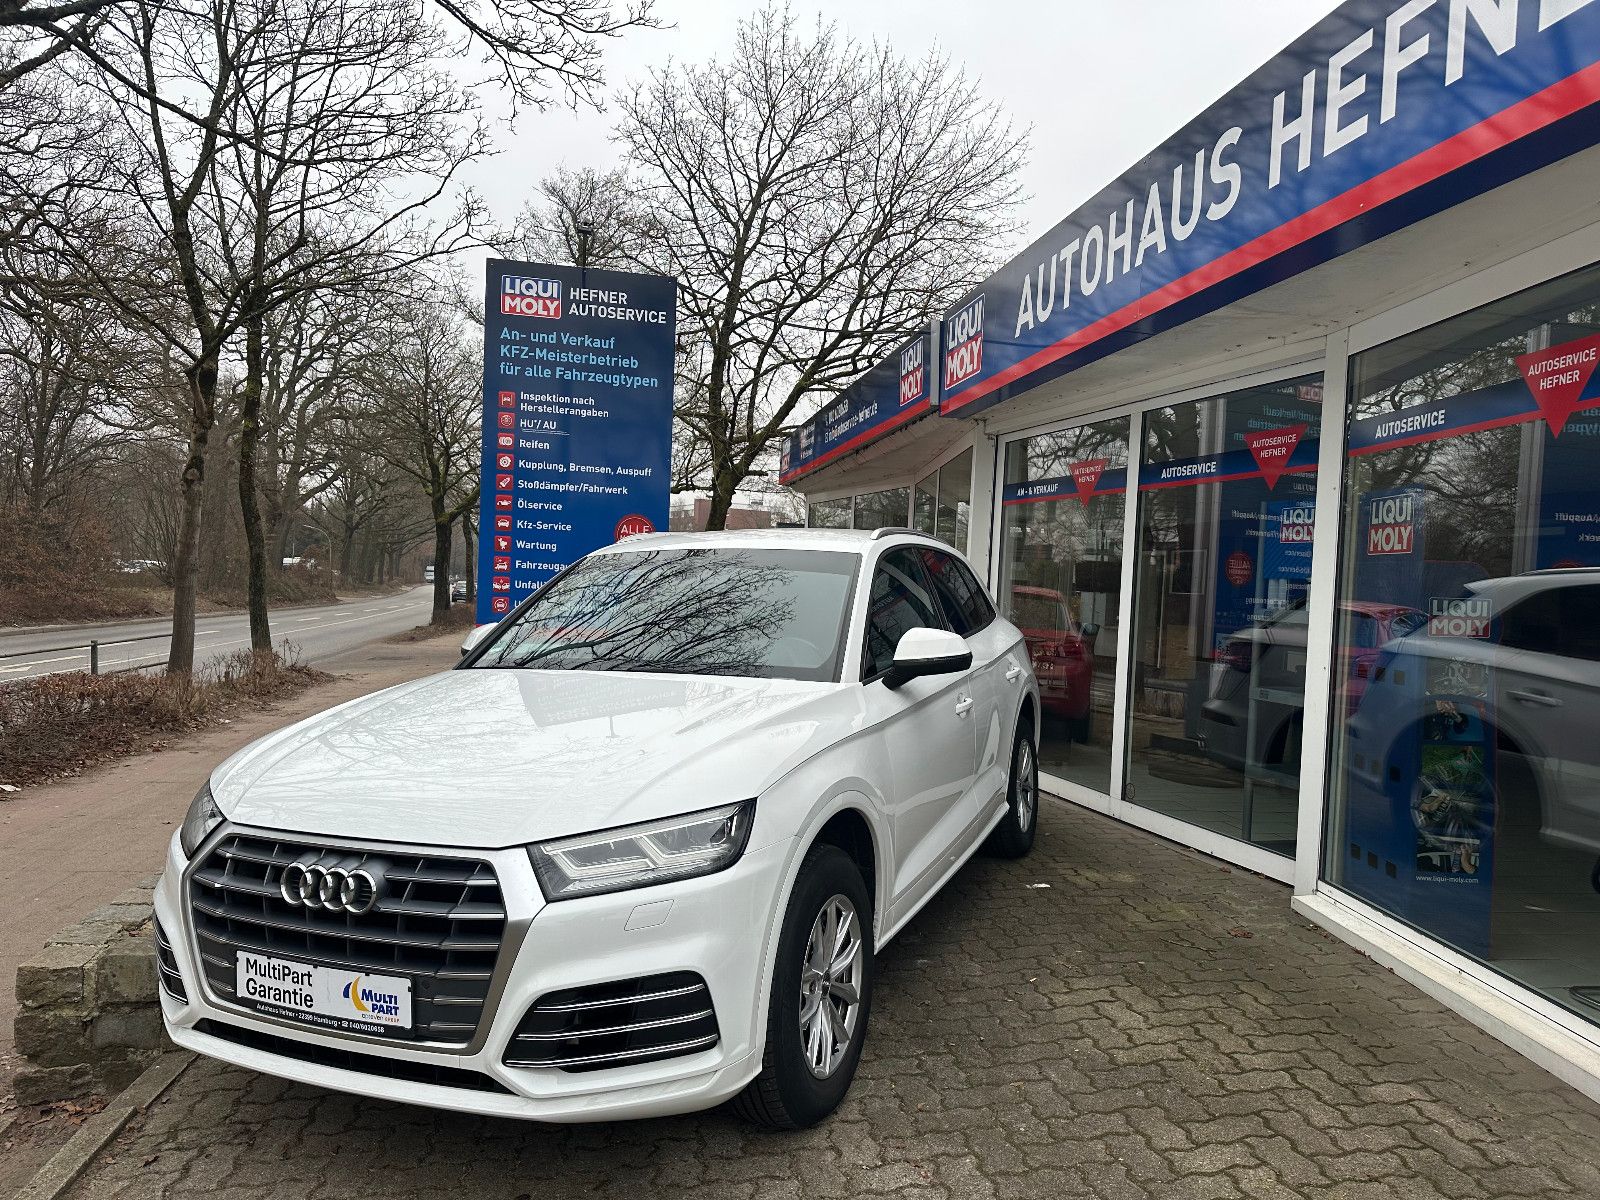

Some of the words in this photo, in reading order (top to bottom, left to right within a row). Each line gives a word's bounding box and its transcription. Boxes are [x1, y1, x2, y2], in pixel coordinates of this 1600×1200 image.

[1015, 126, 1242, 338] AUTOHAUS
[1268, 0, 1597, 189] HEFN
[505, 278, 557, 298] LIQUI
[570, 288, 628, 304] HEFNER
[504, 299, 559, 316] MOLY
[569, 303, 667, 324] AUTOSERVICE
[949, 300, 982, 349] LIQUI
[500, 327, 526, 340] An-
[531, 332, 556, 344] und
[561, 332, 615, 349] Verkauf
[500, 345, 638, 369] KFZ-Meisterbetrieb
[901, 341, 922, 375] LIQUI
[946, 339, 980, 385] MOLY
[1528, 347, 1596, 377] AUTOSERVICE
[500, 362, 521, 376] für
[525, 364, 551, 378] alle
[556, 367, 658, 388] Fahrzeugtypen
[1539, 370, 1580, 391] HEFNER
[900, 370, 921, 402] MOLY
[520, 392, 570, 404] Inspektion
[572, 394, 595, 406] nach
[520, 403, 609, 418] Herstellerangaben
[1375, 409, 1445, 439] AUTOSERVICE
[519, 439, 550, 449] Reifen
[1252, 433, 1297, 449] AUTOSERVICE
[1260, 447, 1287, 458] HEFNER
[518, 459, 567, 472] Kupplung,
[569, 463, 614, 475] Bremsen,
[616, 467, 652, 477] Auspuff
[1161, 462, 1217, 479] AUTOSERVICE
[517, 480, 628, 495] Stoßdämpfer/Fahrwerk
[1033, 483, 1059, 495] VERKAUF
[517, 498, 563, 511] Ölservice
[1371, 497, 1412, 525] LIQUI
[516, 519, 572, 531] Kfz-Service
[1283, 508, 1315, 524] LIQU
[516, 540, 557, 552] Wartung
[1369, 525, 1412, 553] MOLY
[1432, 598, 1488, 617] LIQUI
[1431, 617, 1489, 636] MOLY
[1416, 874, 1479, 884] www.liqui-moly.com
[246, 957, 313, 988] MultiPart
[246, 977, 314, 1009] Garantie
[361, 988, 398, 1005] MULTI
[256, 1003, 279, 1014] Autohaus
[279, 1008, 296, 1018] Hefner
[313, 1015, 338, 1027] Hamburg
[371, 1003, 399, 1017] PART
